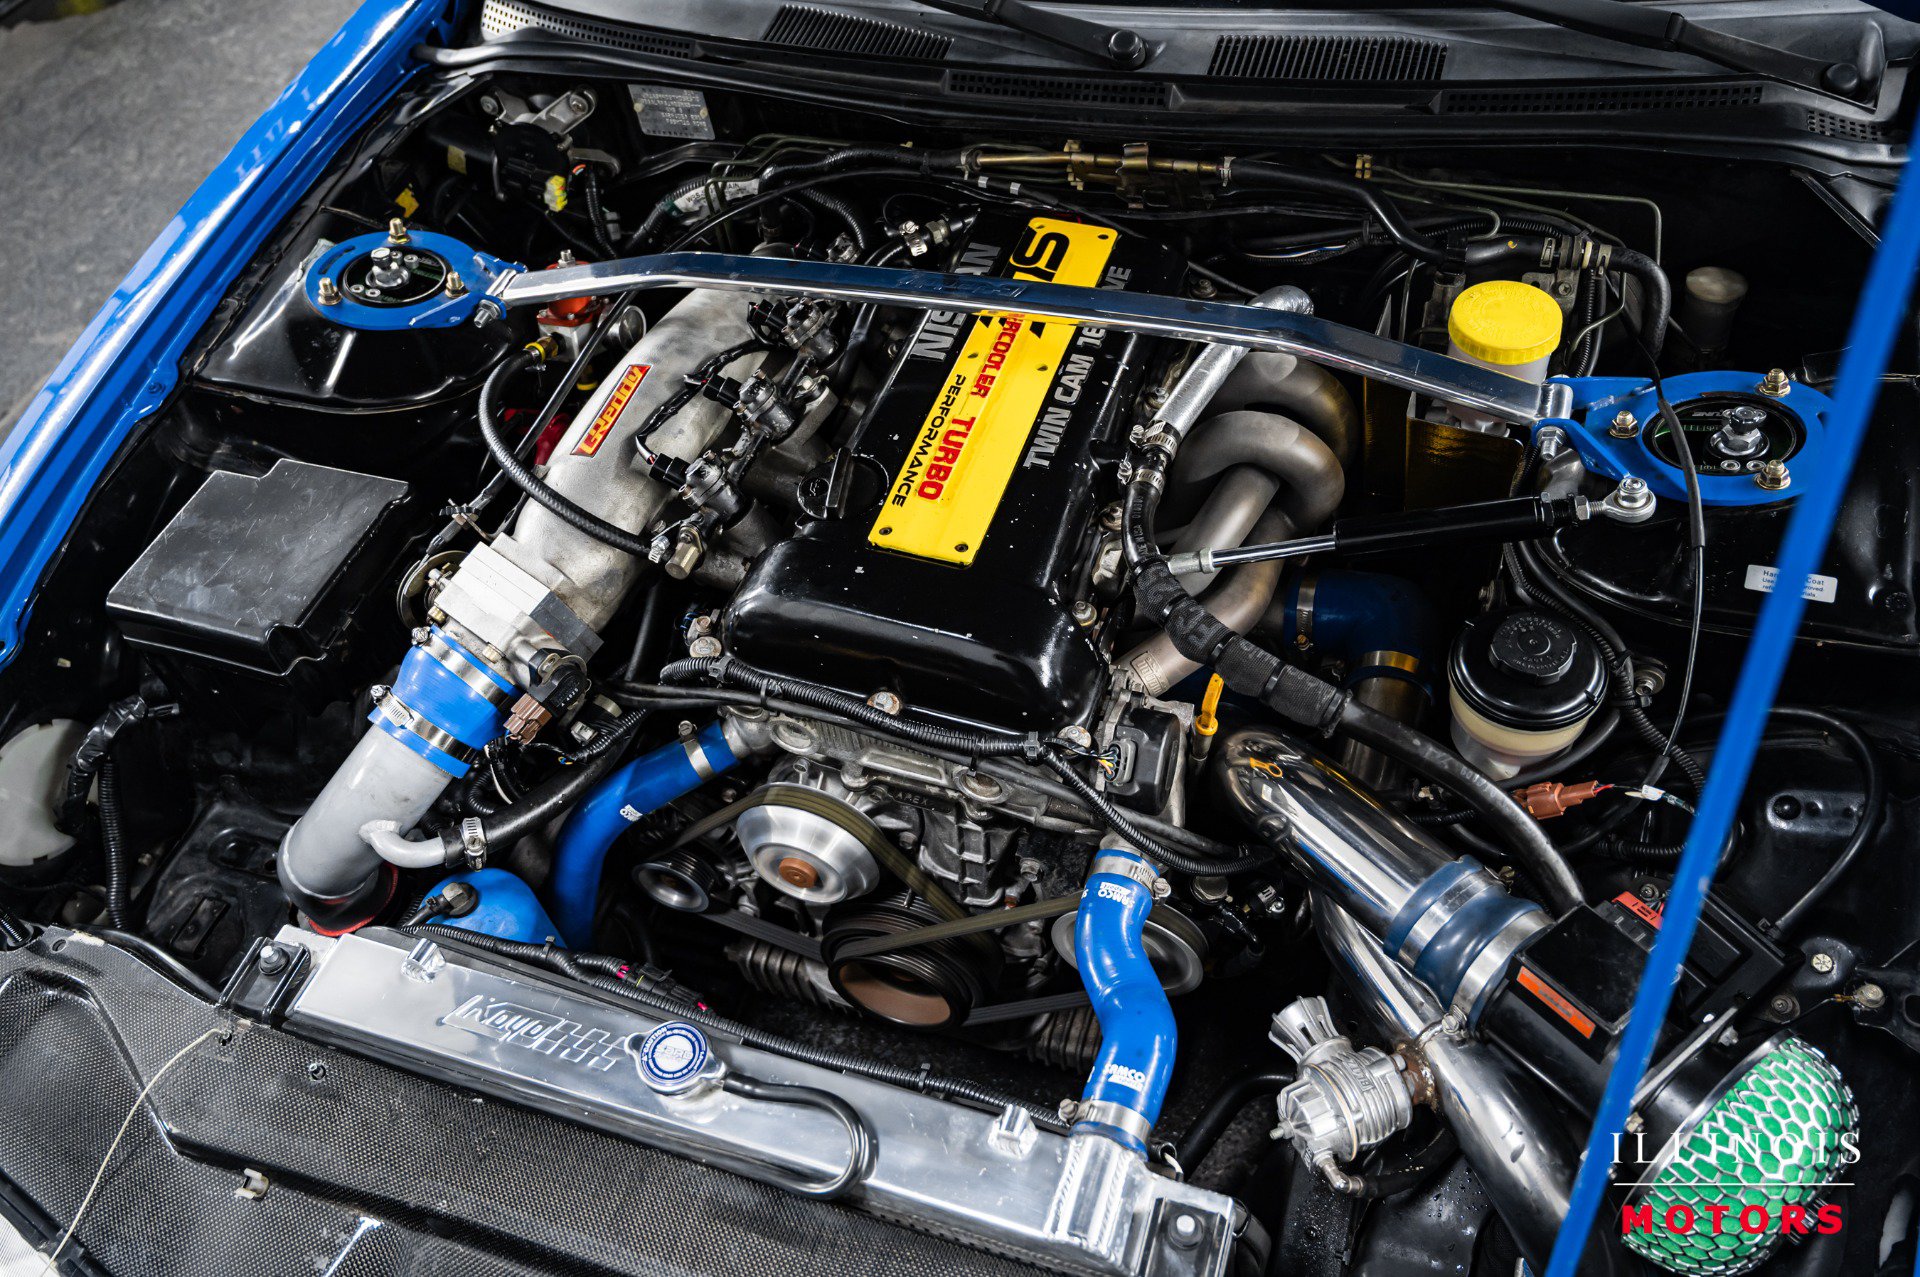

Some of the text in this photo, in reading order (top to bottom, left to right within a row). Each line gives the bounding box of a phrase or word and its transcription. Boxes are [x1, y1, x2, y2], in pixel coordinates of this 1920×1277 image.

[909, 242, 1000, 362] NISAN
[891, 373, 966, 507] PERFORMANCE
[917, 416, 976, 501] TURBO
[1023, 407, 1071, 470] TWIN
[1054, 354, 1095, 404] CAM
